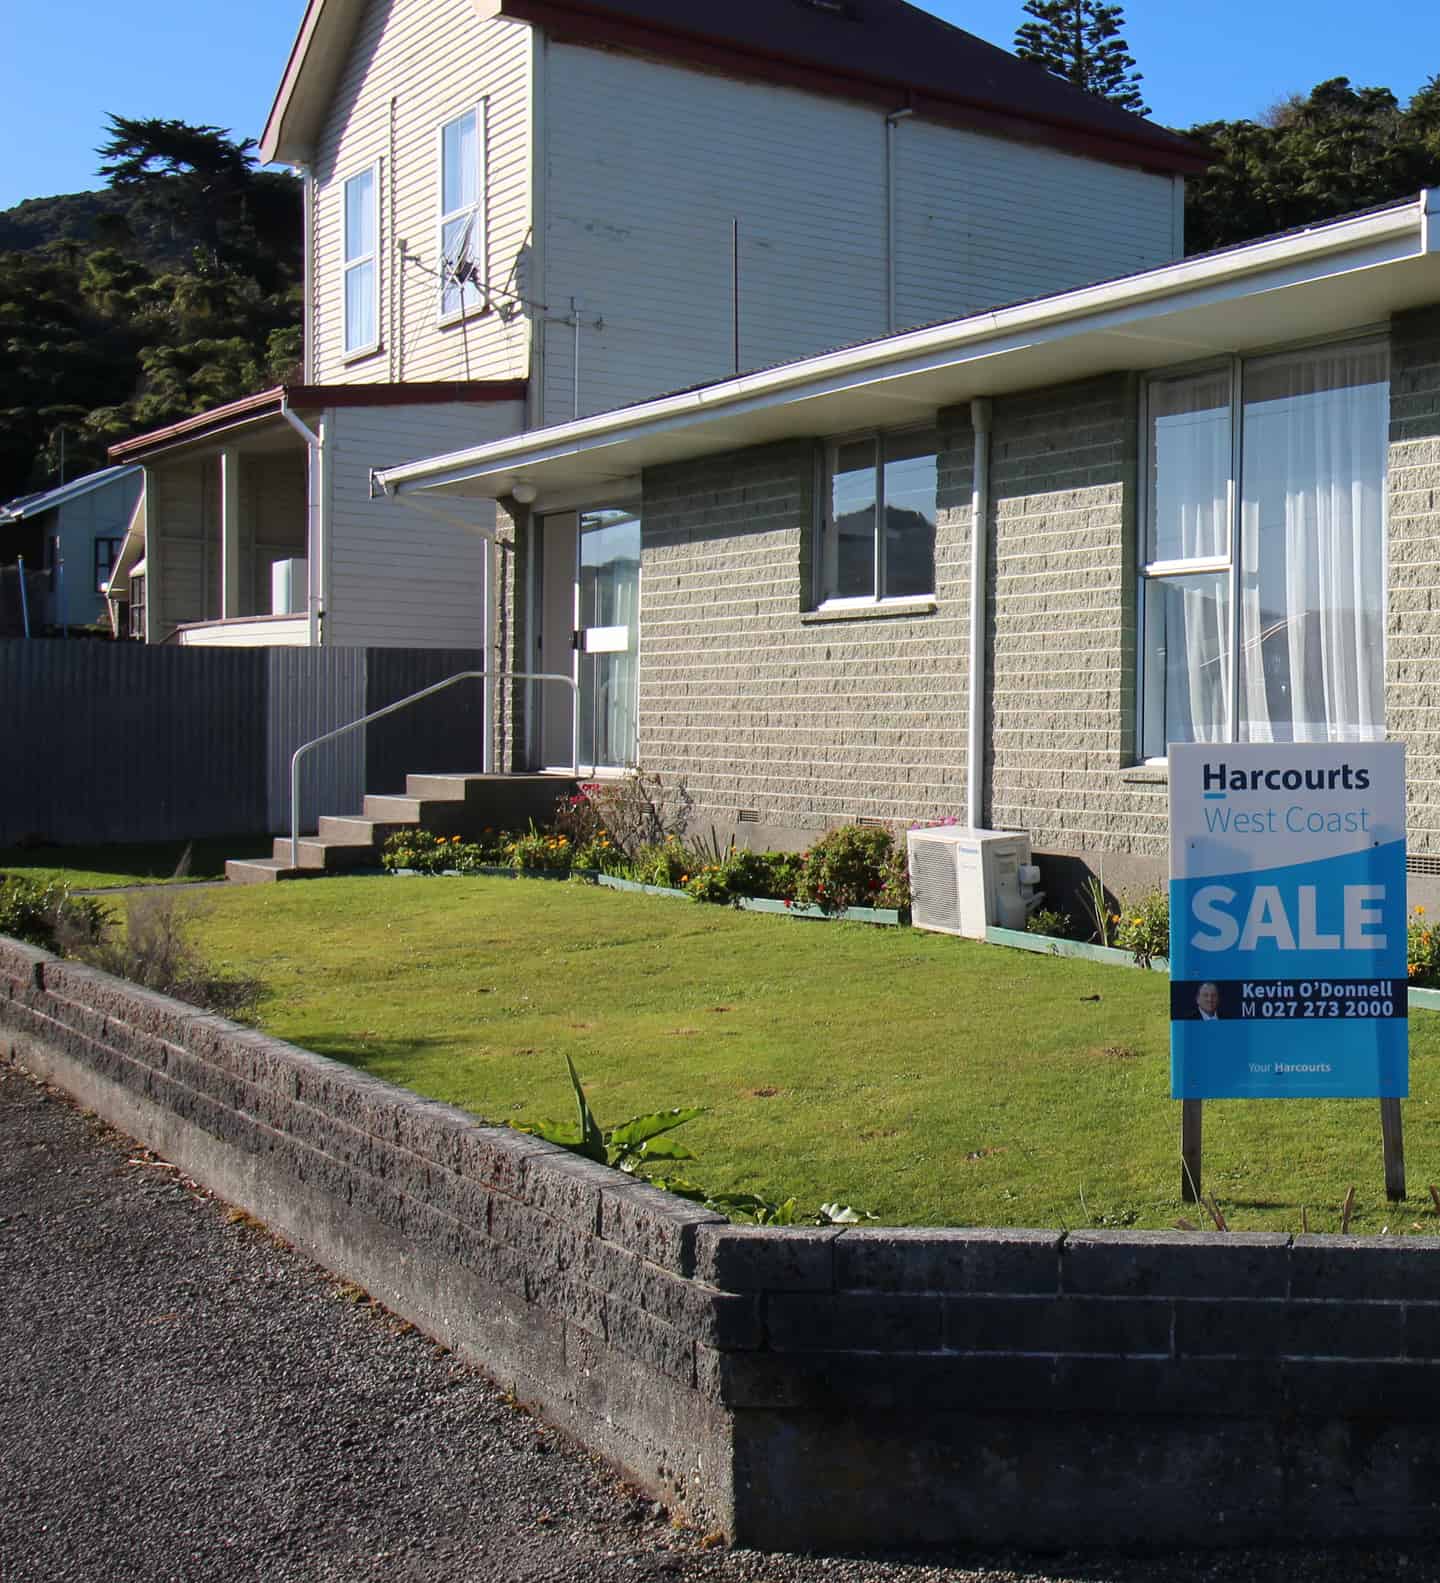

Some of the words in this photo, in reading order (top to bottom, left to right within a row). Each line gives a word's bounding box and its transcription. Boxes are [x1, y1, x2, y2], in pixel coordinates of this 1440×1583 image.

[1203, 763, 1370, 791] Harcourts
[1204, 807, 1276, 833] West
[1286, 806, 1369, 833] Coast
[1191, 885, 1388, 952] SALE
[1242, 981, 1294, 998] Kevin
[1299, 981, 1393, 998] O'Donnell
[1242, 1002, 1256, 1017] M
[1262, 1002, 1298, 1017] 027
[1303, 1002, 1339, 1017] 273
[1345, 1001, 1394, 1017] 2000
[1248, 1063, 1271, 1073] Your
[1274, 1063, 1332, 1073] Harcourts
